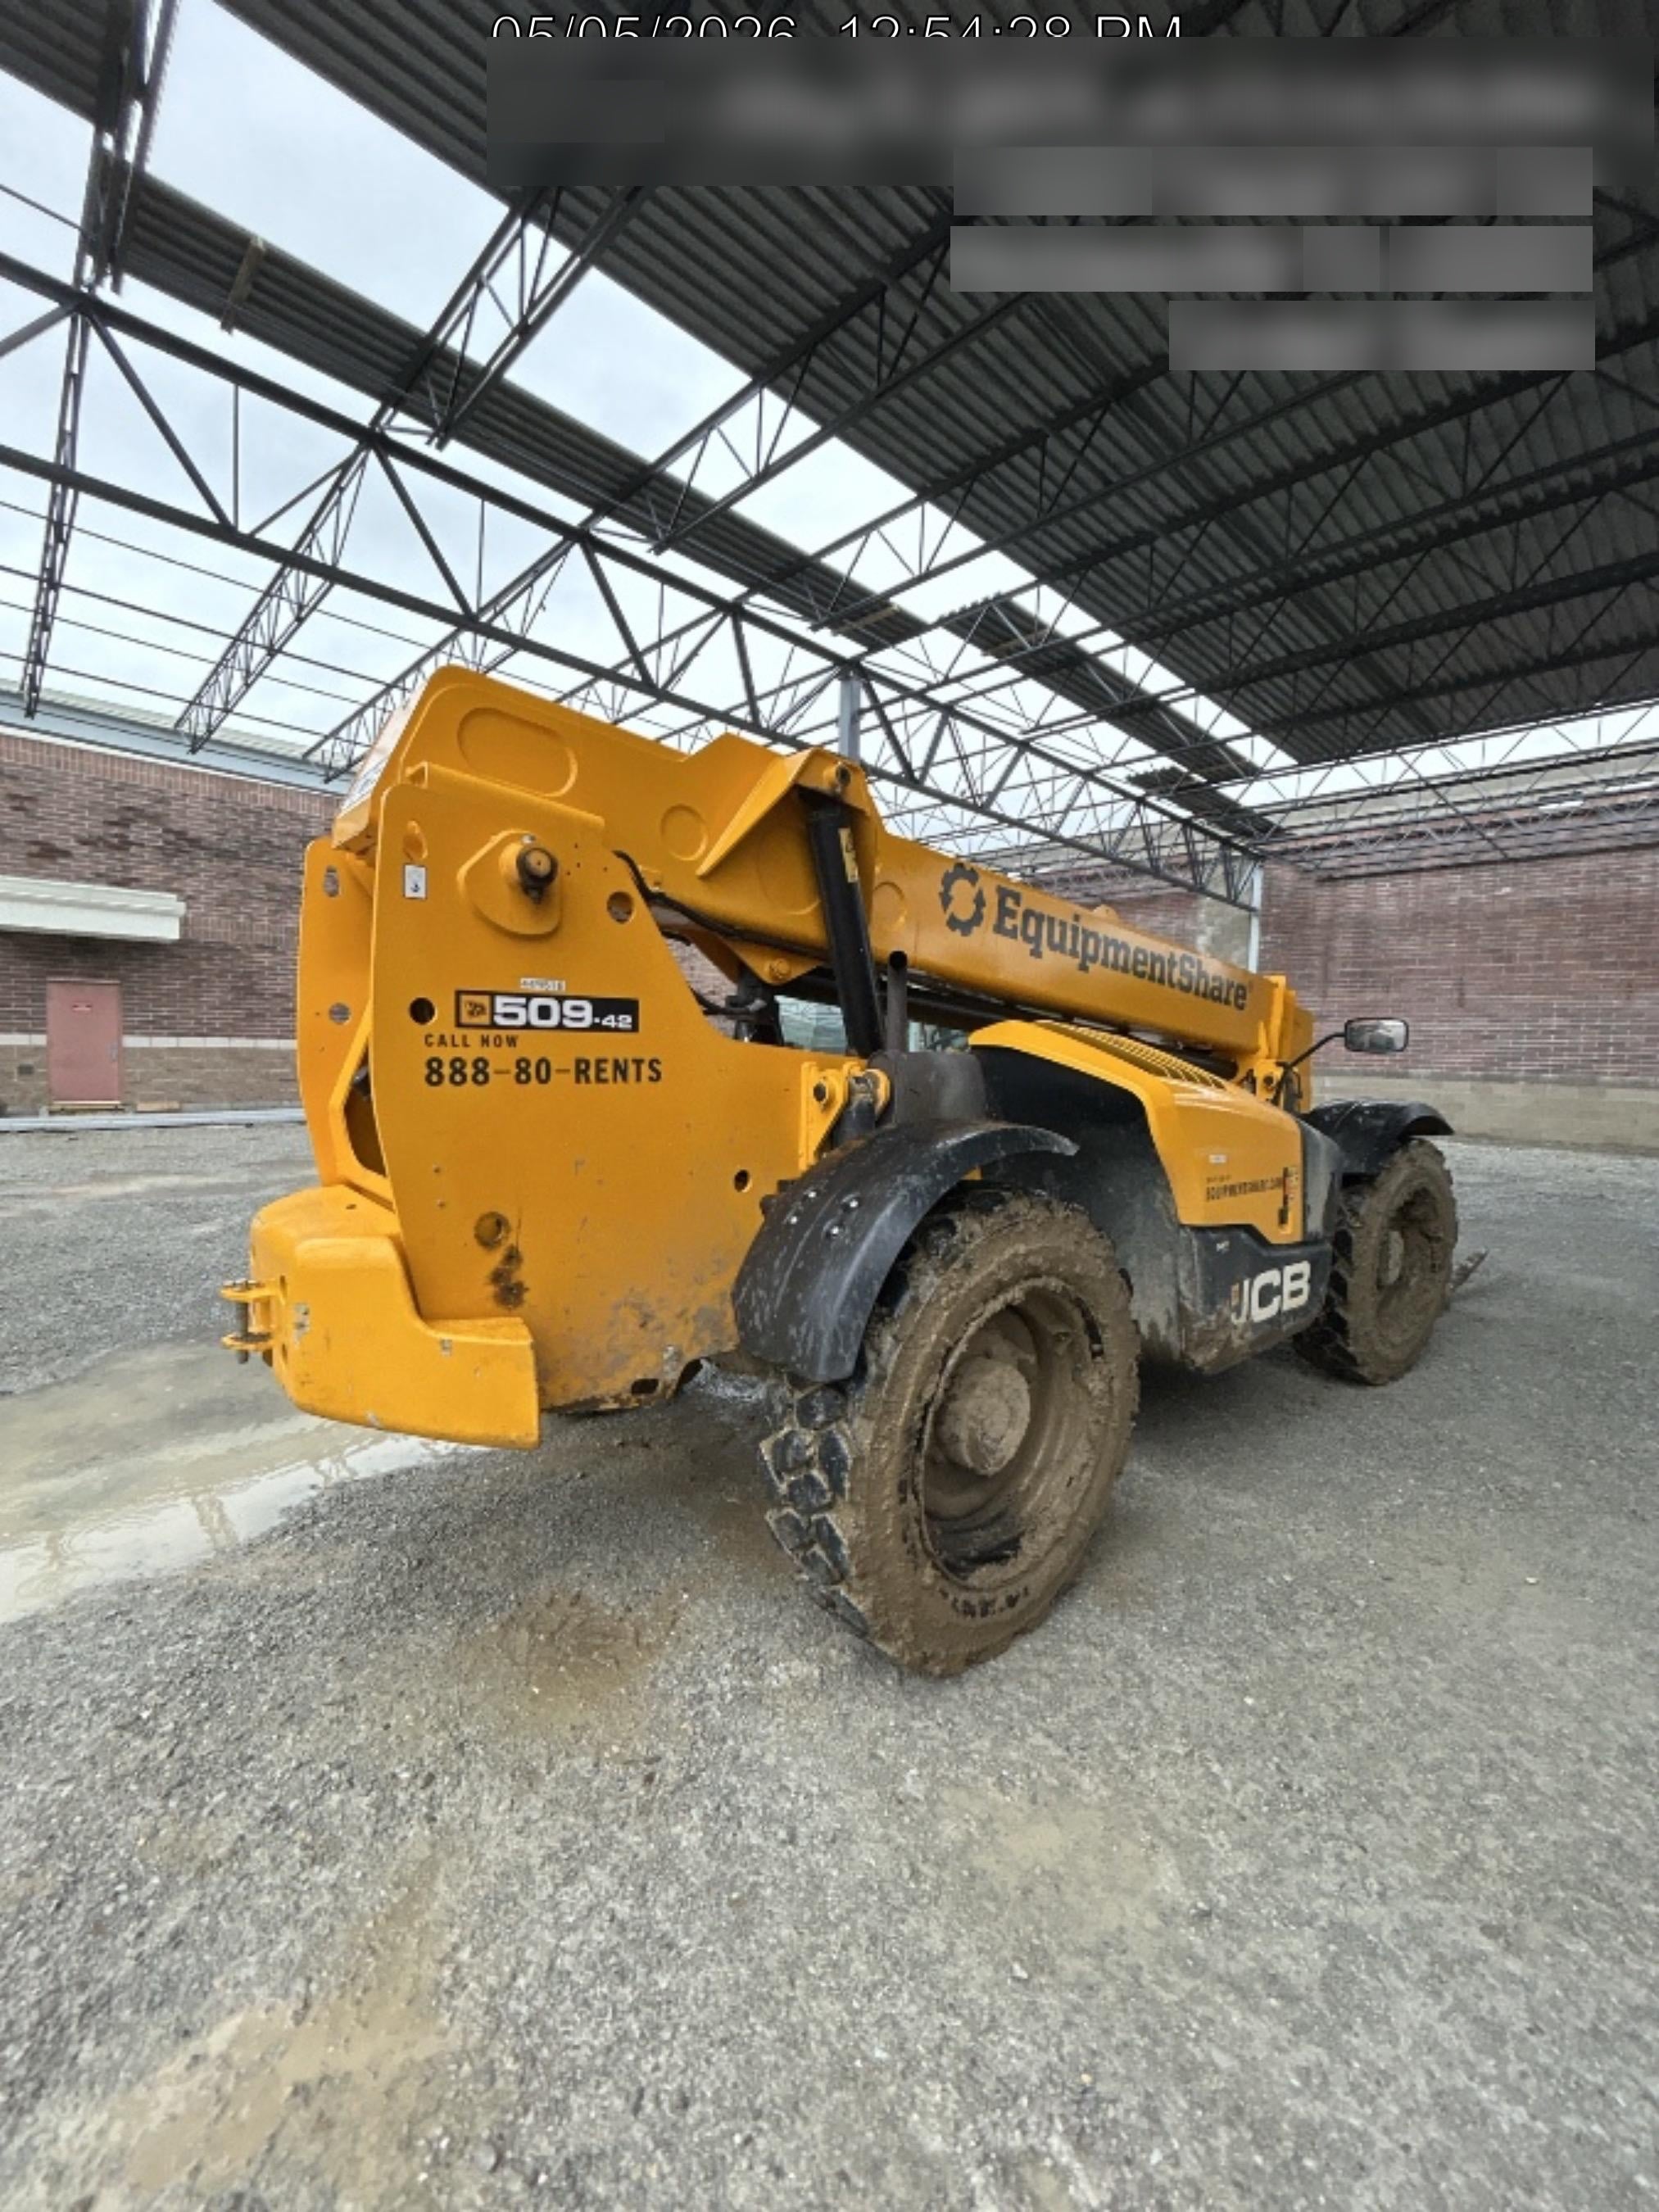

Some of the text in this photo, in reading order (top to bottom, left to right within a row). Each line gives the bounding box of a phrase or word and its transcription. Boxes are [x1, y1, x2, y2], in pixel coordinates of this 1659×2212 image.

[992, 884, 1249, 1011] EquipmentShare
[424, 1033, 519, 1048] CALL NOW
[424, 1056, 662, 1087] 888-80-RENTS
[1231, 1260, 1311, 1325] JCB
